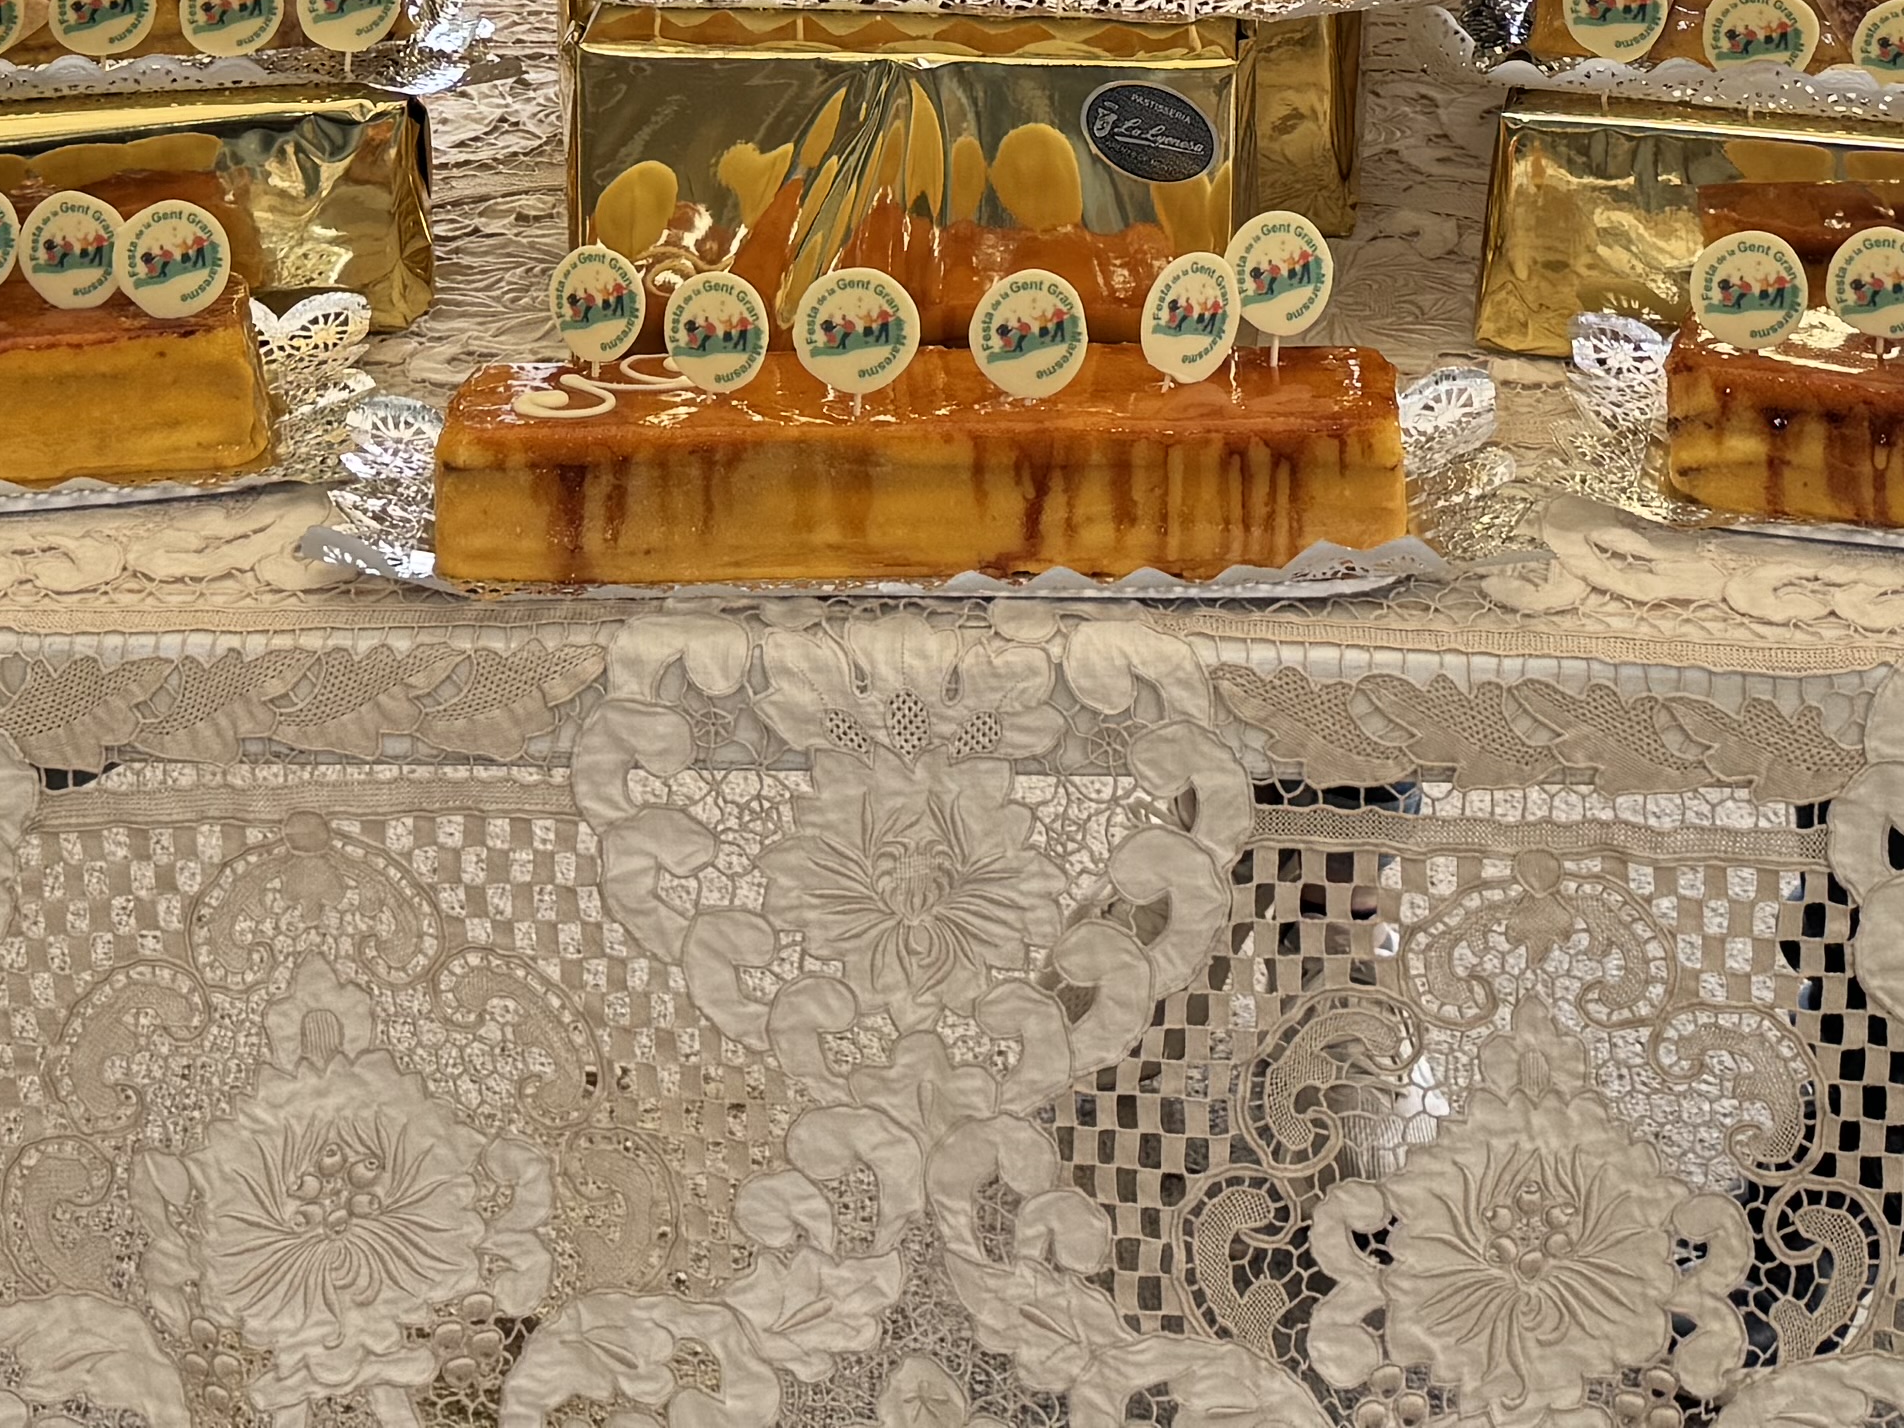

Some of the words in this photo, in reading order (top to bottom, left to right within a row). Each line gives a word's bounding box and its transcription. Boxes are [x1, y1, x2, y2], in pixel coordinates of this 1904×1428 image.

[127, 240, 139, 278] Festa
[151, 210, 183, 223] Gent
[186, 213, 212, 238] Gran
[1237, 254, 1248, 295] Festa
[1261, 222, 1291, 236] Gent
[1294, 225, 1318, 252] Gran
[1702, 264, 1718, 301] Festa
[1737, 241, 1771, 256] Gent
[1774, 251, 1797, 281] Gran
[1835, 266, 1848, 304] Festa
[1863, 238, 1896, 250] Gent
[670, 304, 685, 343] Festa
[702, 280, 734, 295] Gent
[737, 290, 758, 322] Gran
[806, 306, 820, 345] Festa
[836, 278, 871, 290] Gent
[874, 284, 899, 313] Gran
[982, 311, 994, 351] Festa
[1010, 280, 1044, 293] Gent
[1047, 283, 1074, 311] Gran
[1191, 262, 1216, 279] Gent
[1215, 275, 1229, 307] Gran
